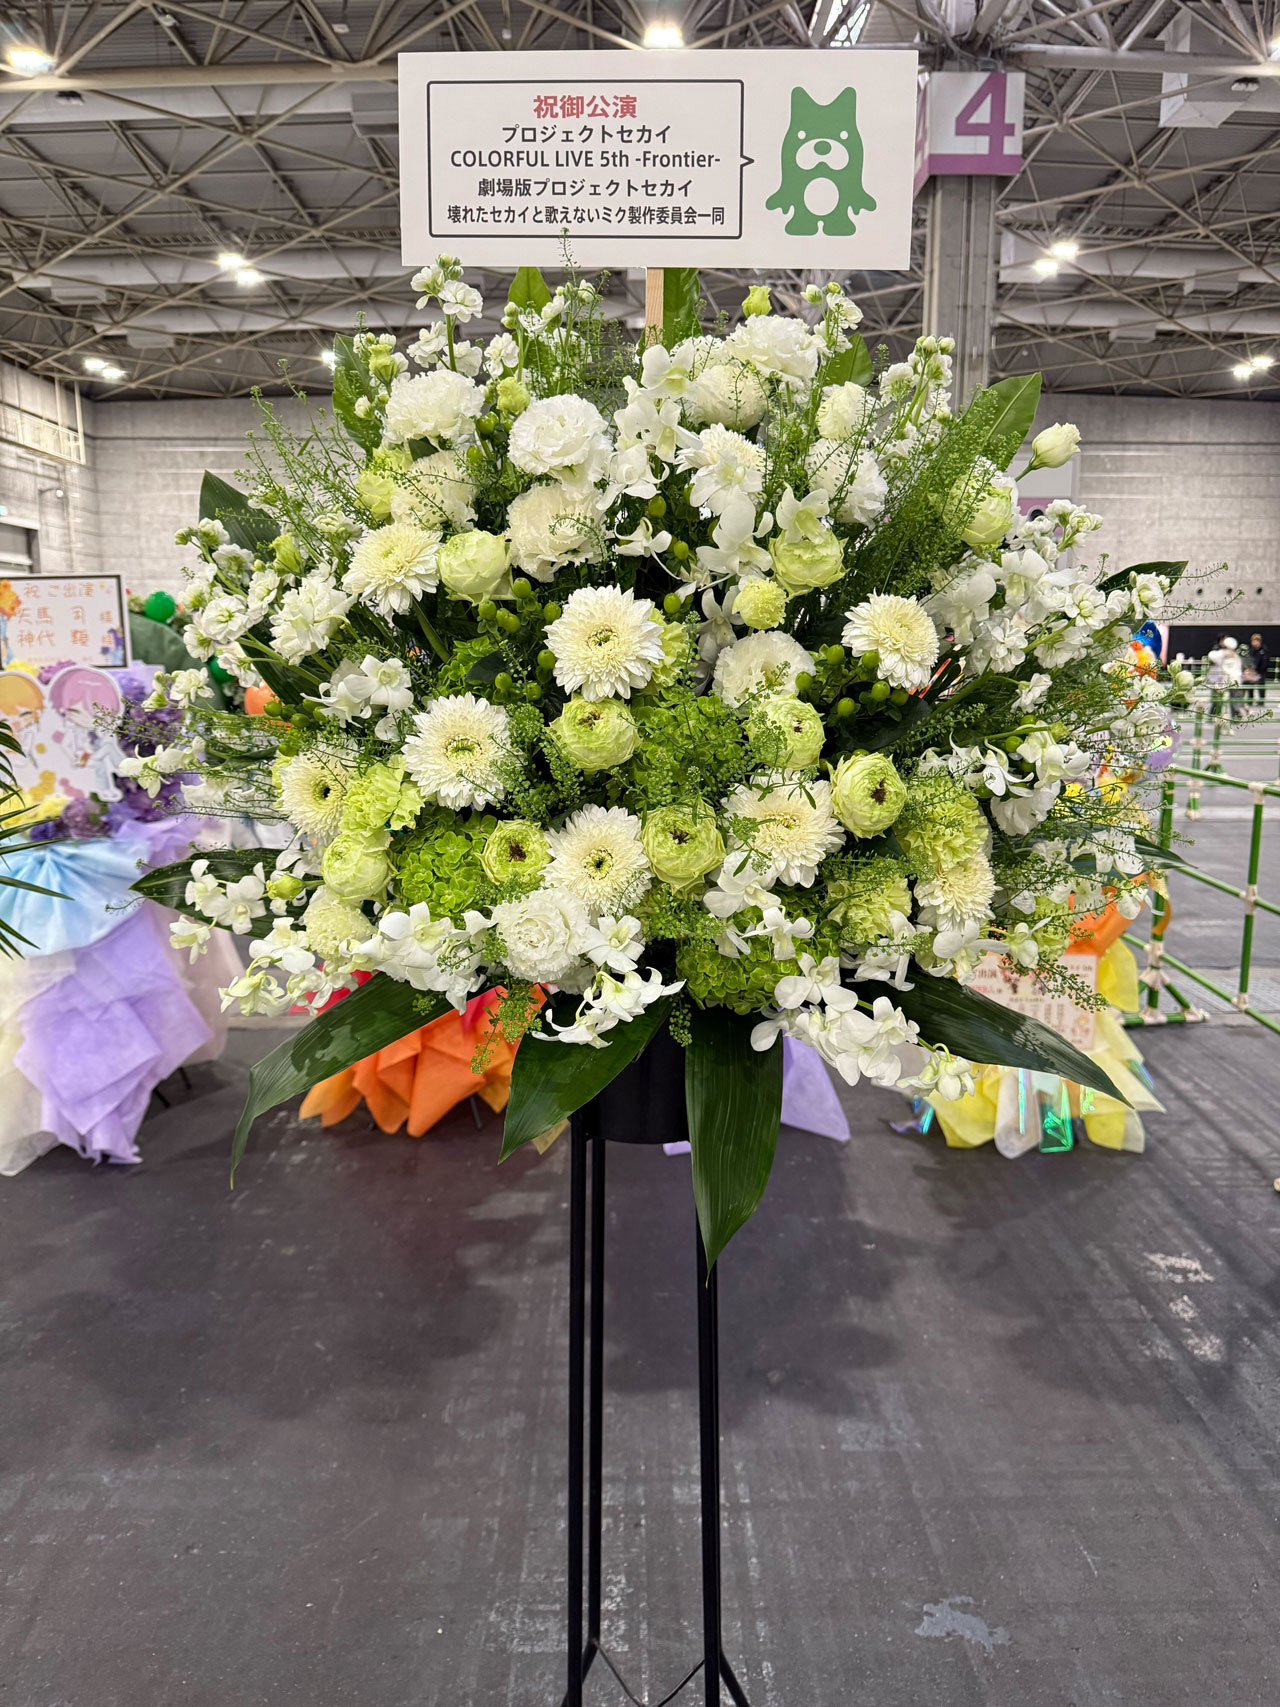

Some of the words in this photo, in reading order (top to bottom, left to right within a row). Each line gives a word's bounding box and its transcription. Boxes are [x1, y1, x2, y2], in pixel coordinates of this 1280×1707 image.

[533, 95, 637, 119] 祝御公演
[955, 72, 1015, 154] 4
[502, 123, 671, 144] プロジェクトセカイ
[450, 150, 550, 168] COLORFUL
[555, 150, 594, 168] LIVE
[600, 149, 629, 168] 5th
[635, 150, 721, 168] -Frontier-
[478, 177, 693, 198] 劇場版プロジェクトセカイ
[447, 204, 725, 226] 壊れたセカイと歌えないミク製作委員会一同
